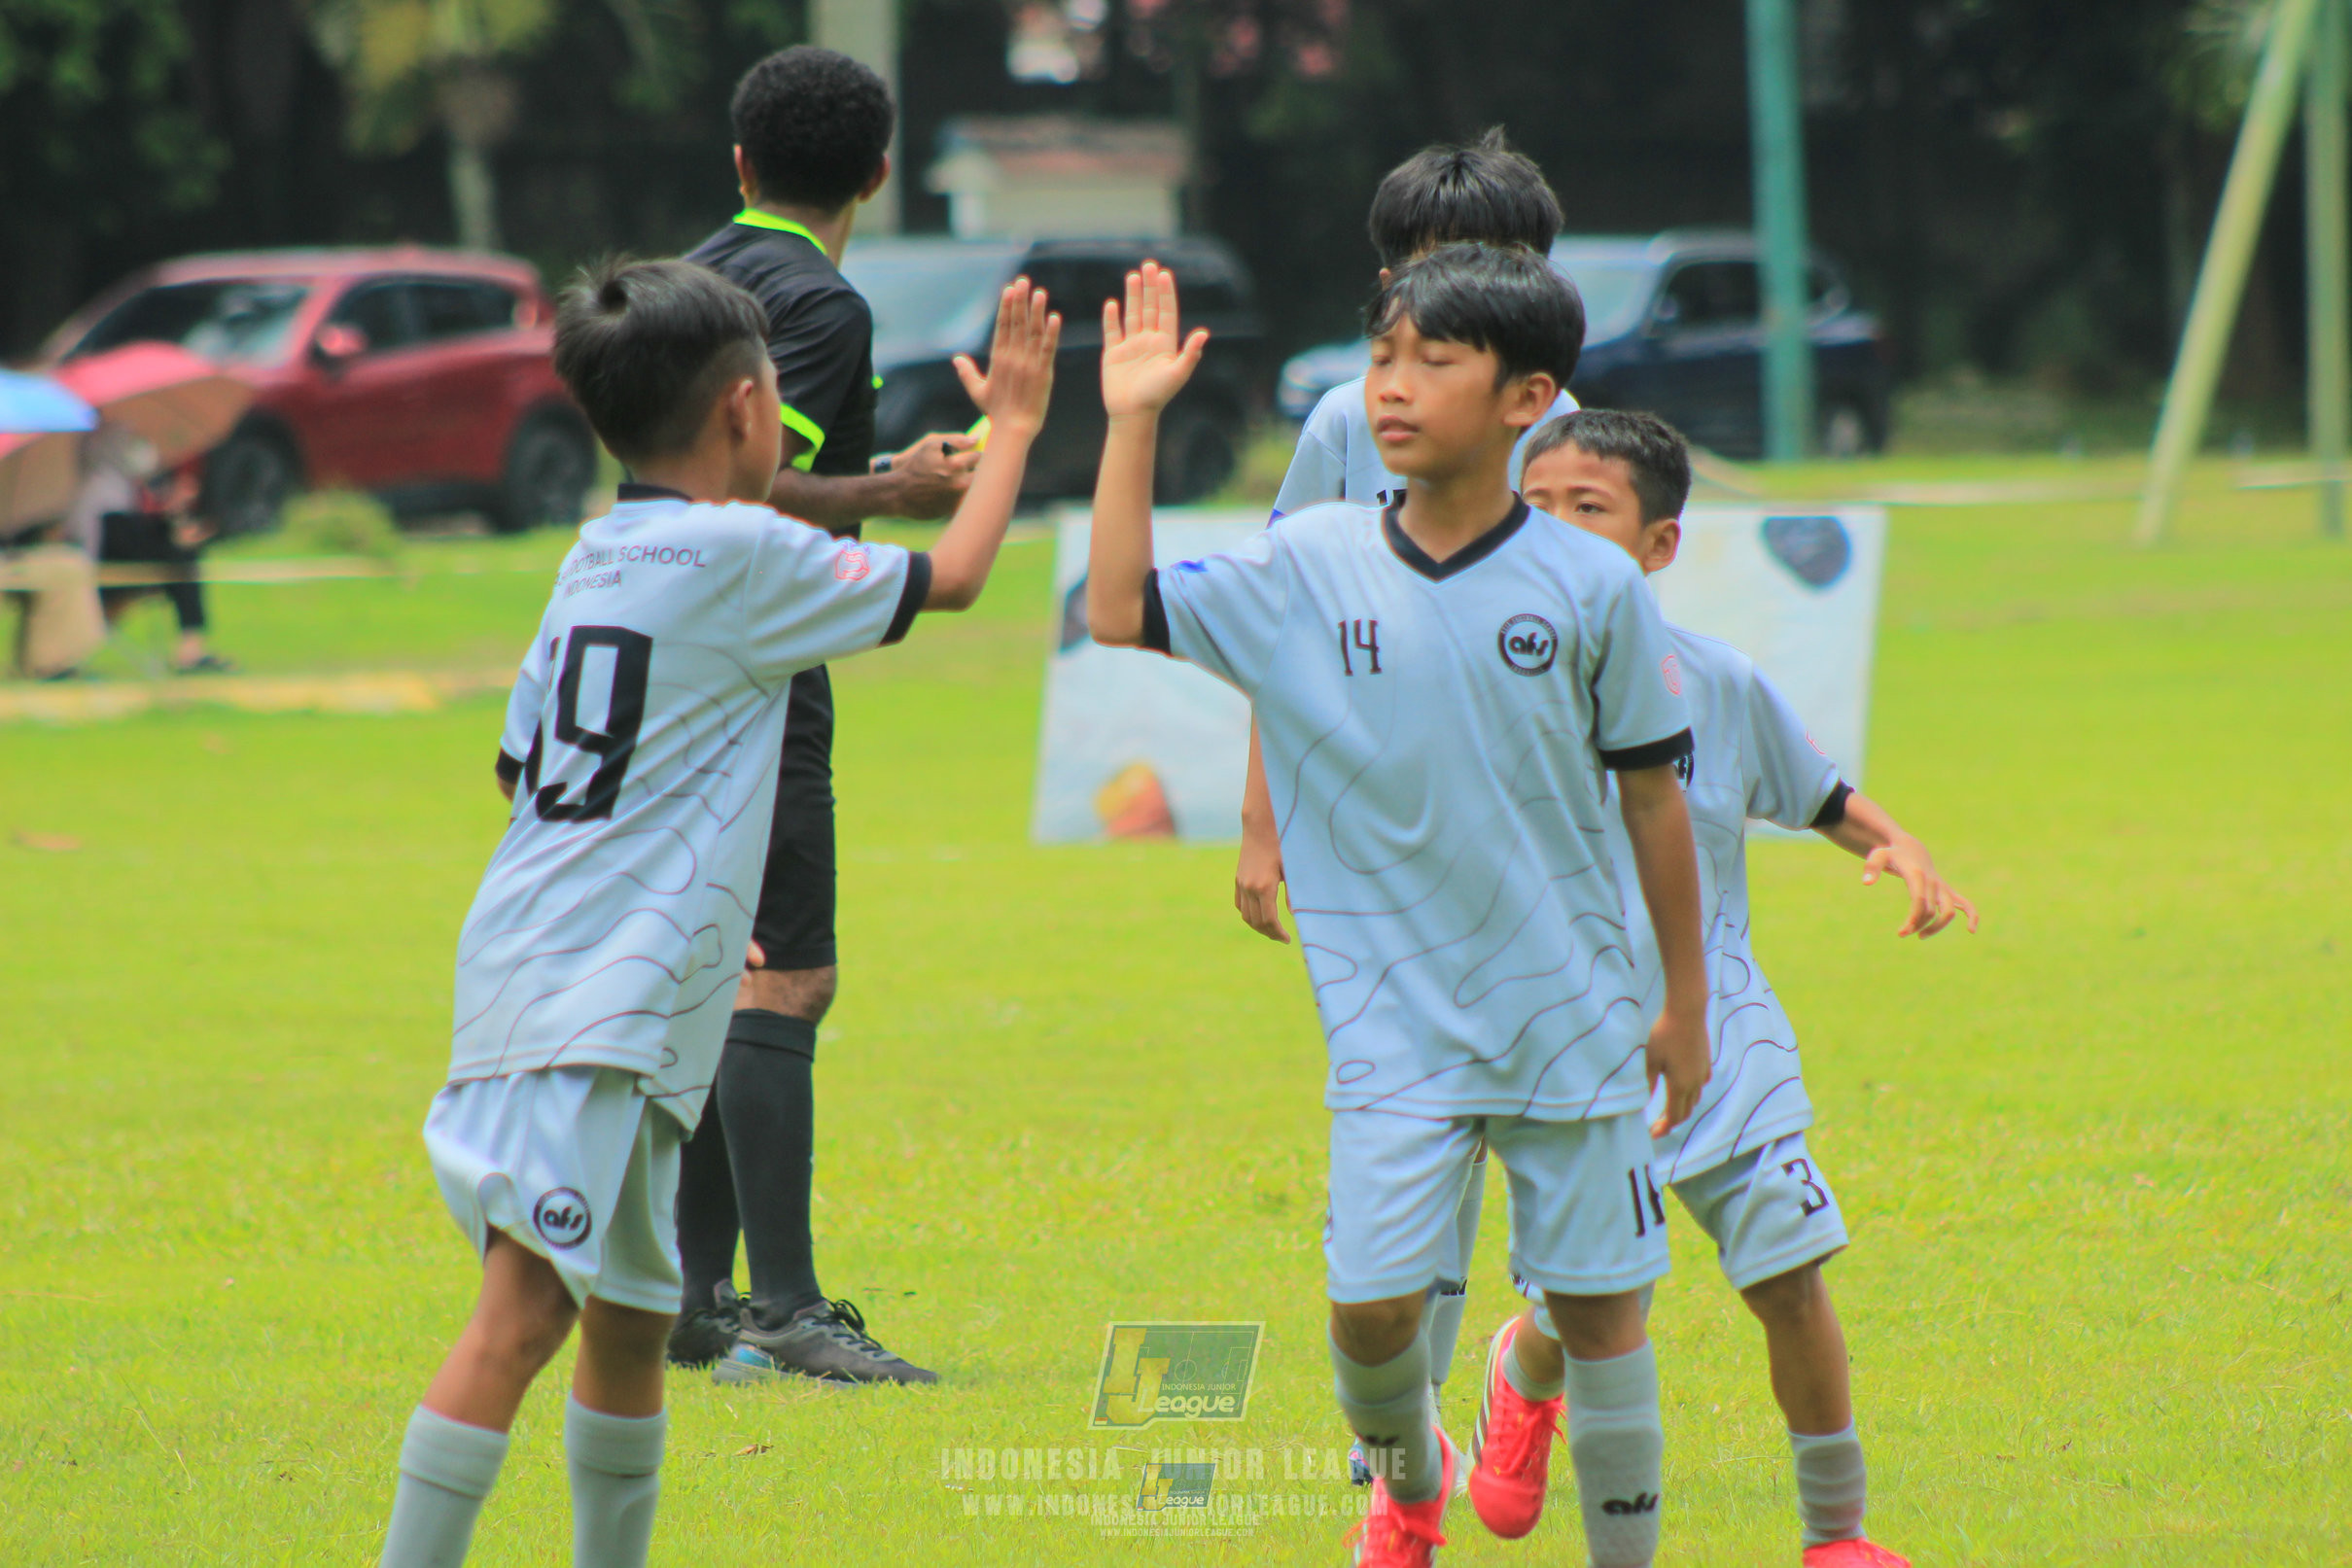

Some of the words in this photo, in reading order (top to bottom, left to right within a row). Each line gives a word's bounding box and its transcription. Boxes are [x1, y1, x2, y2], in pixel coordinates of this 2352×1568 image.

[616, 544, 707, 569] SCHOOL
[1338, 618, 1383, 677] 14
[1781, 1158, 1830, 1218] 3
